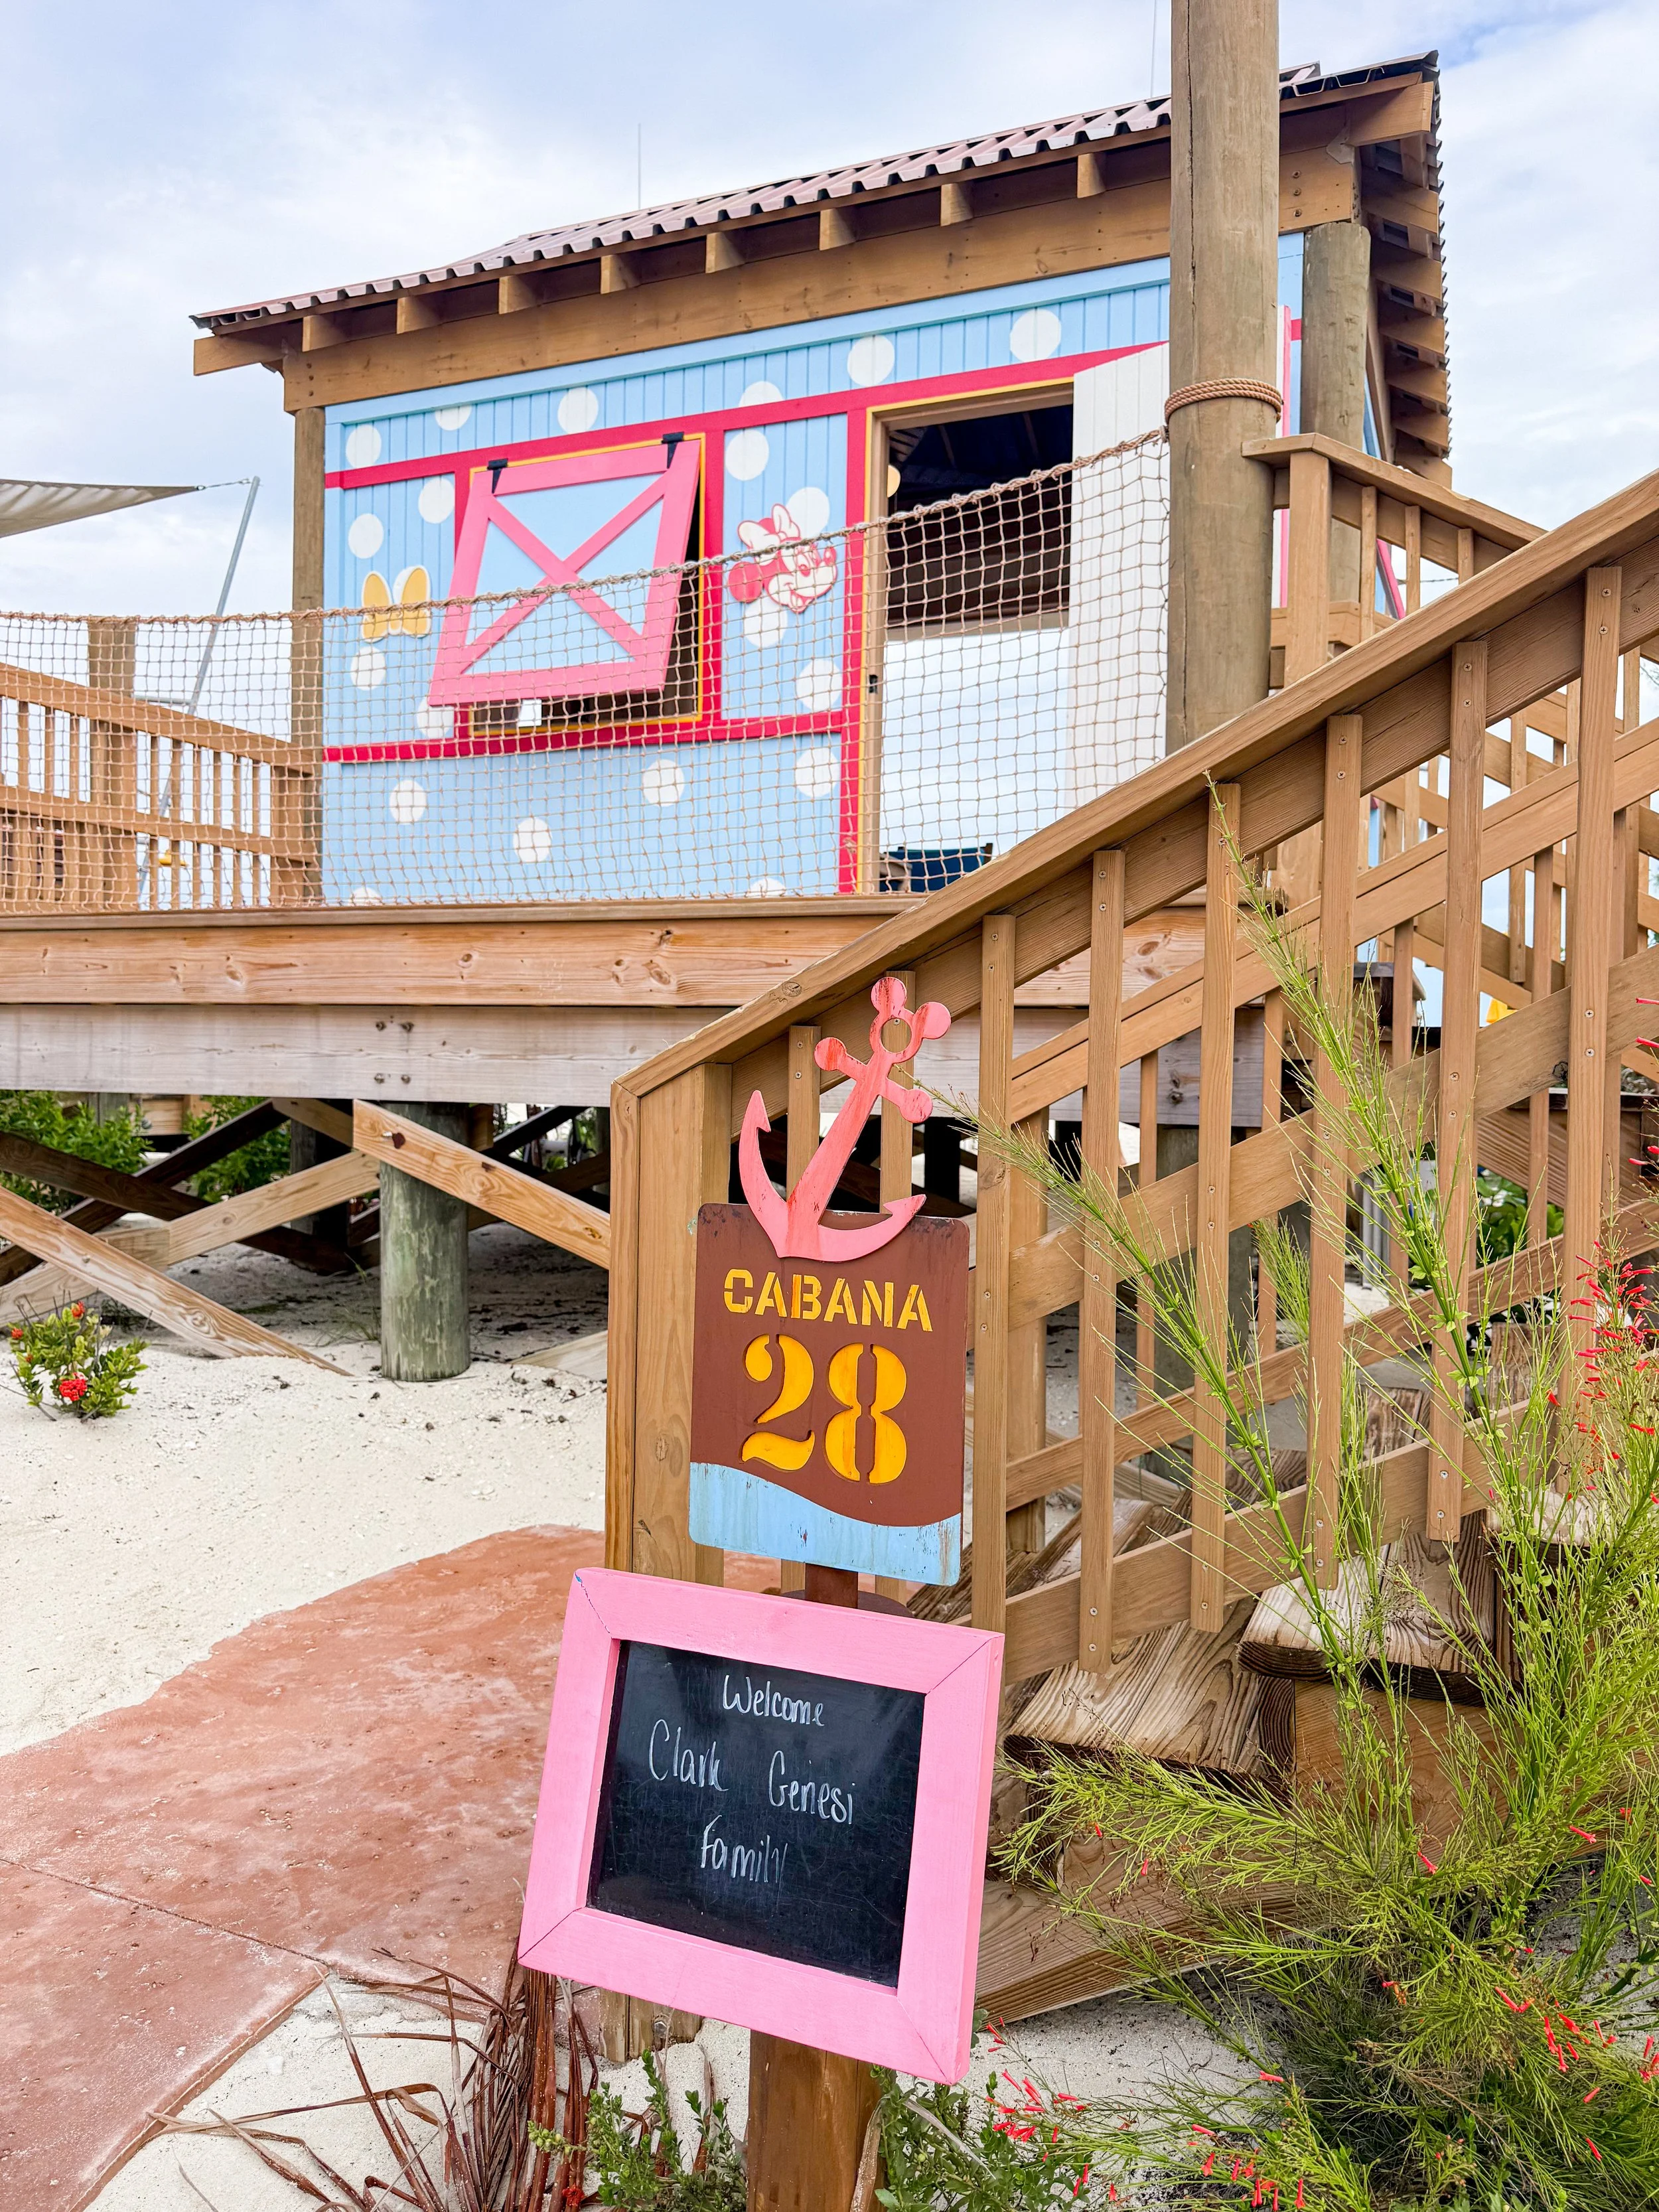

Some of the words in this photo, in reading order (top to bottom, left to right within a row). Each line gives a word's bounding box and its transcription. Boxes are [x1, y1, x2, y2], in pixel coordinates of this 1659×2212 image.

[724, 1269, 932, 1332] CABANA
[739, 1333, 907, 1485] 28
[723, 1674, 825, 1727] Welcome
[648, 1719, 729, 1791] Clark
[768, 1750, 855, 1824] Genesi
